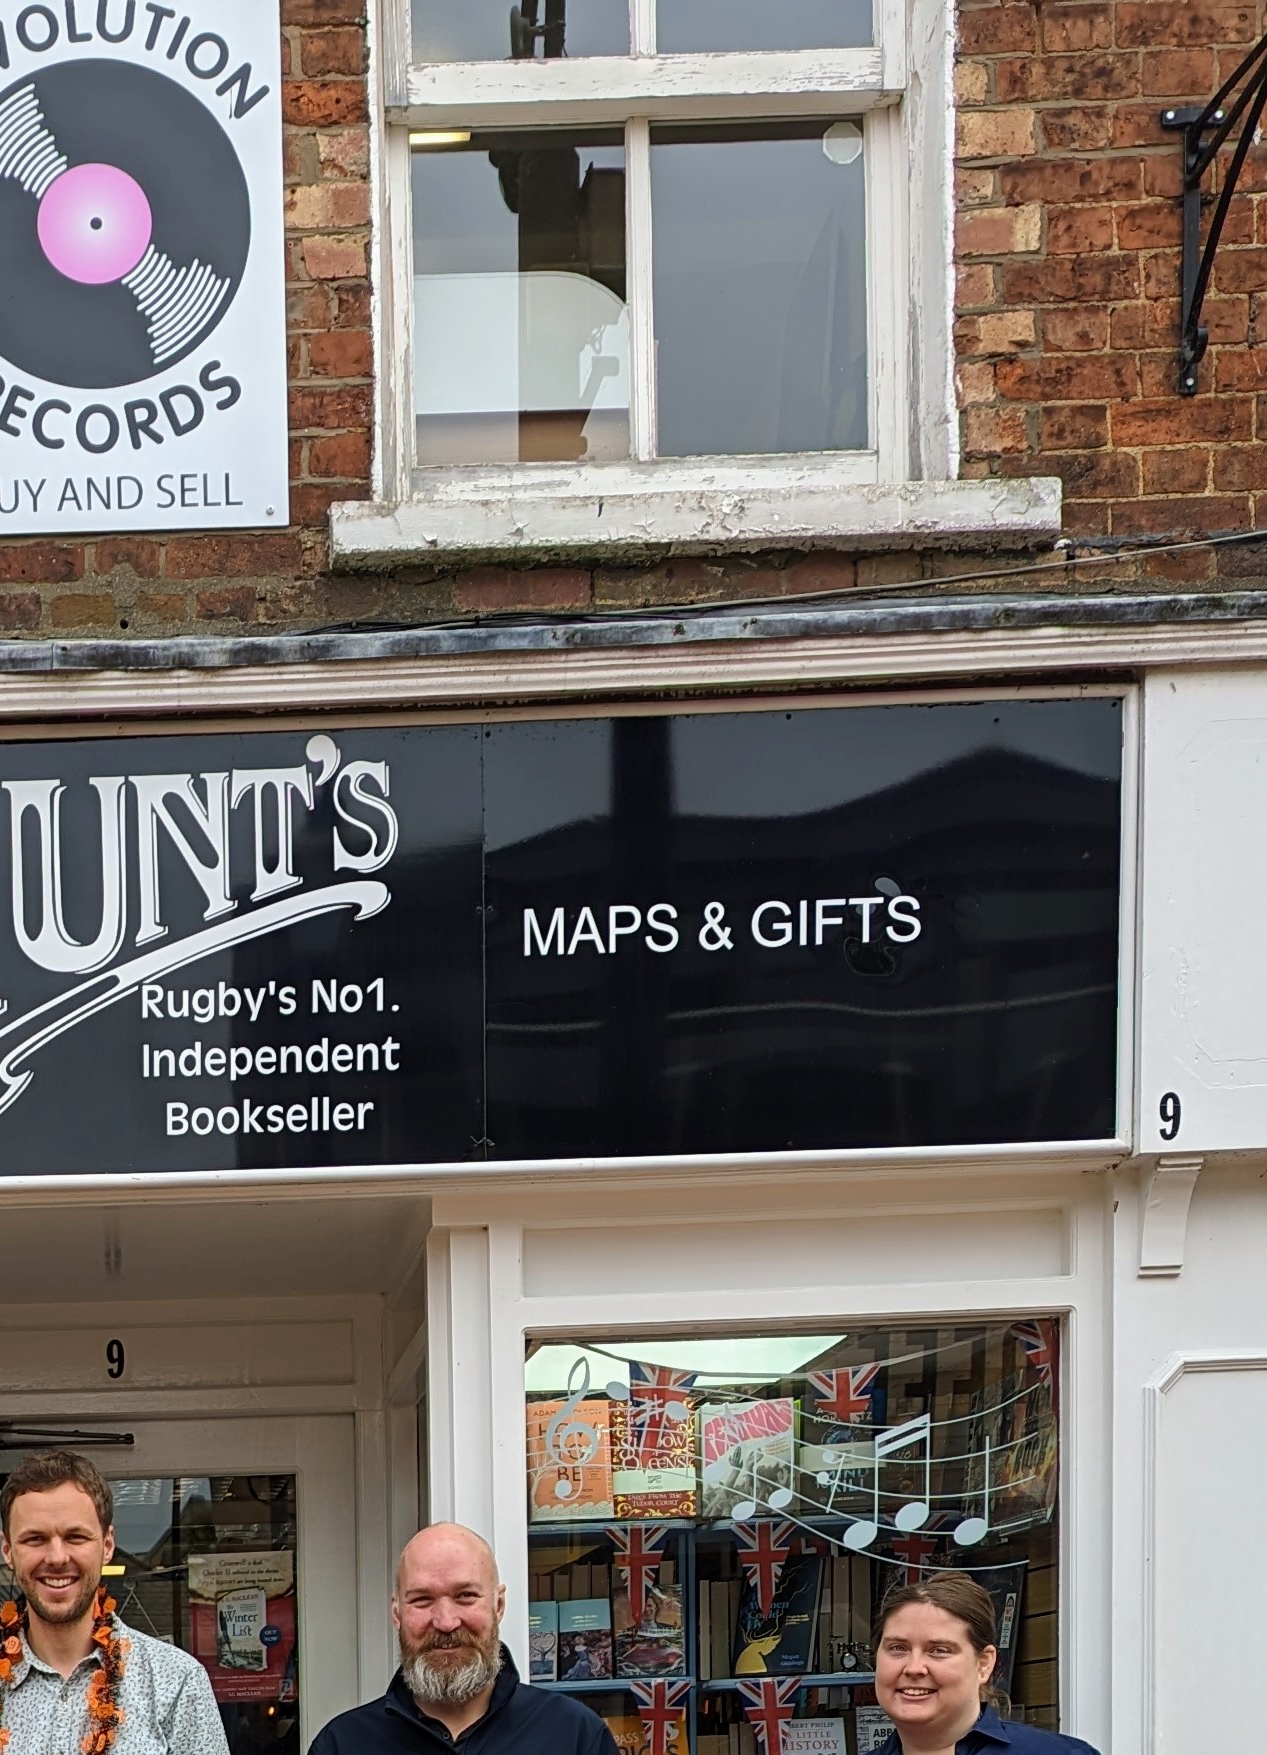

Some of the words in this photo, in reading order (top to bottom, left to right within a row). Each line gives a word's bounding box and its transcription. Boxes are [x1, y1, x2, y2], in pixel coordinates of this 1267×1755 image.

[58, 475, 144, 512] AND
[156, 472, 244, 509] SELL
[522, 903, 679, 957] MAPS
[698, 901, 734, 951] &
[750, 896, 922, 949] GIFTS
[141, 981, 297, 1023] Rugby's
[311, 978, 401, 1014] No1.
[142, 1036, 401, 1081] Independent
[165, 1097, 375, 1136] Bookseller
[1159, 1091, 1182, 1141] 9
[105, 1338, 125, 1379] 9
[533, 1409, 557, 1417] ADAM
[557, 1466, 582, 1482] BE
[224, 1609, 259, 1623] Winter
[232, 1623, 253, 1637] List
[797, 1731, 832, 1739] LITTLE
